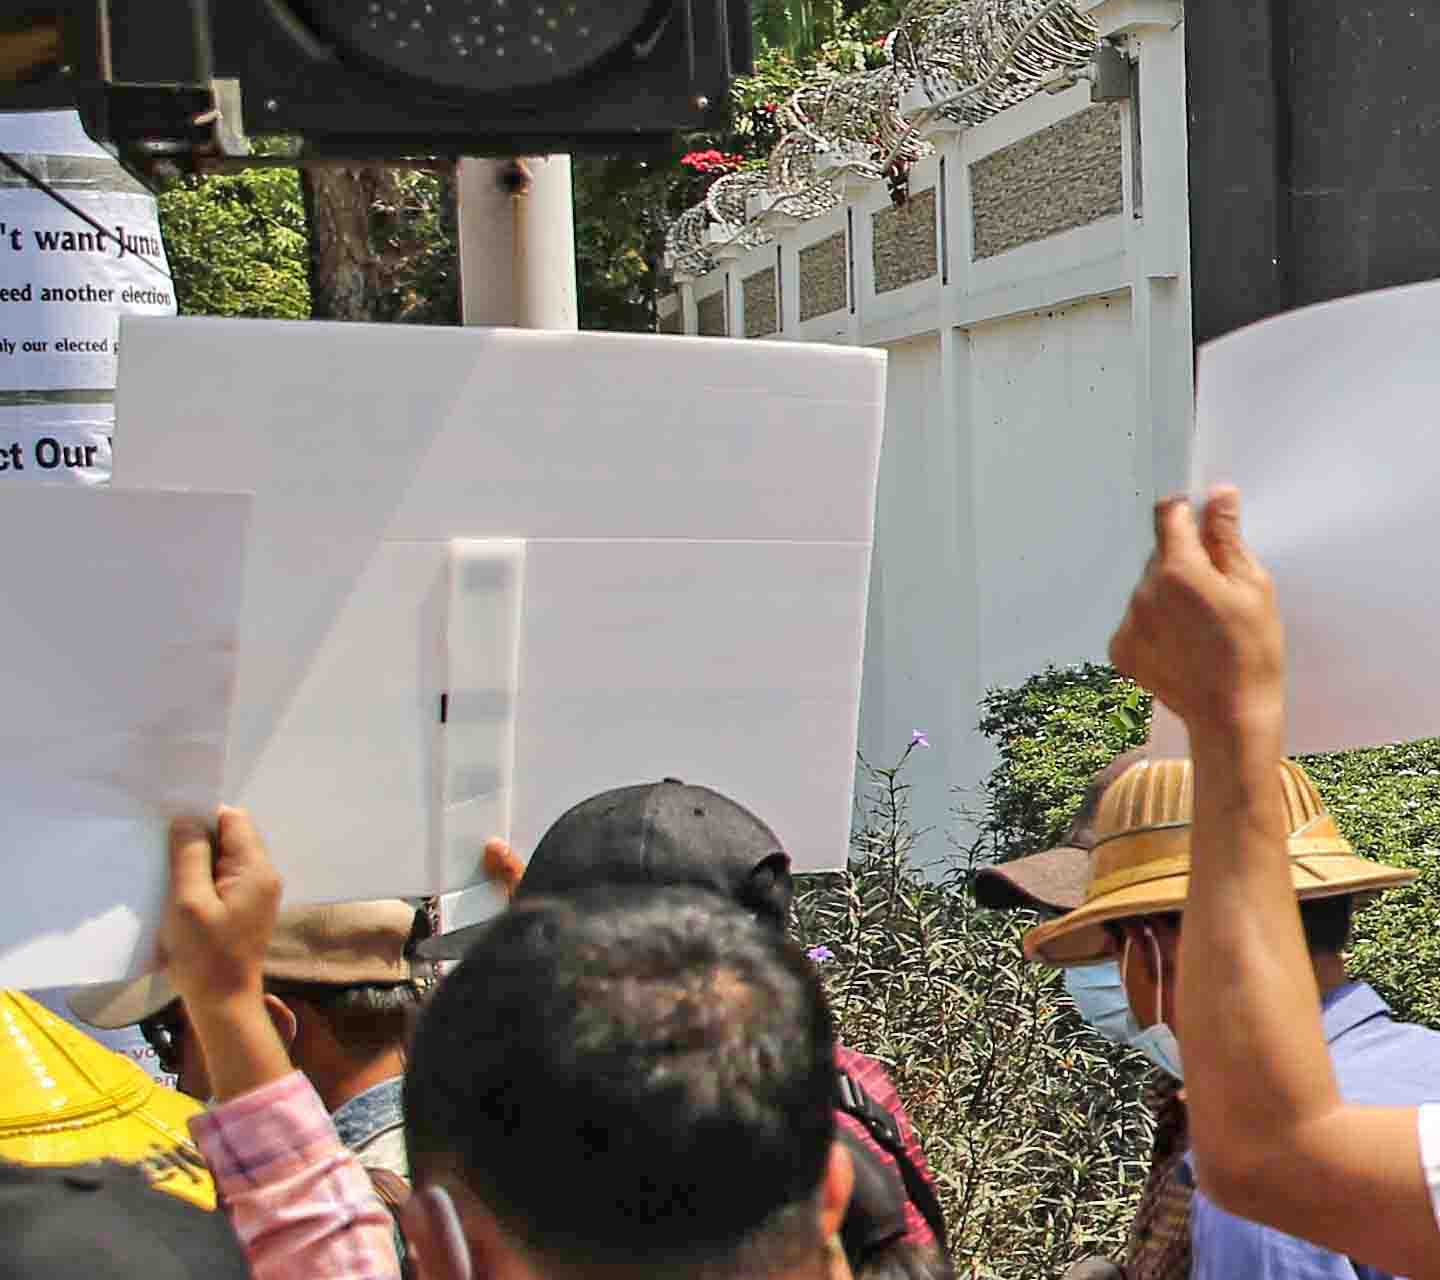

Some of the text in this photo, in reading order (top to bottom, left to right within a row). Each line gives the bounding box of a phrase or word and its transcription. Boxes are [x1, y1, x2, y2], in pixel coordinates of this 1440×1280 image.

[34, 229, 107, 252] want
[40, 283, 117, 303] another
[21, 340, 49, 353] our
[55, 337, 109, 353] elected
[35, 436, 98, 470] Our
